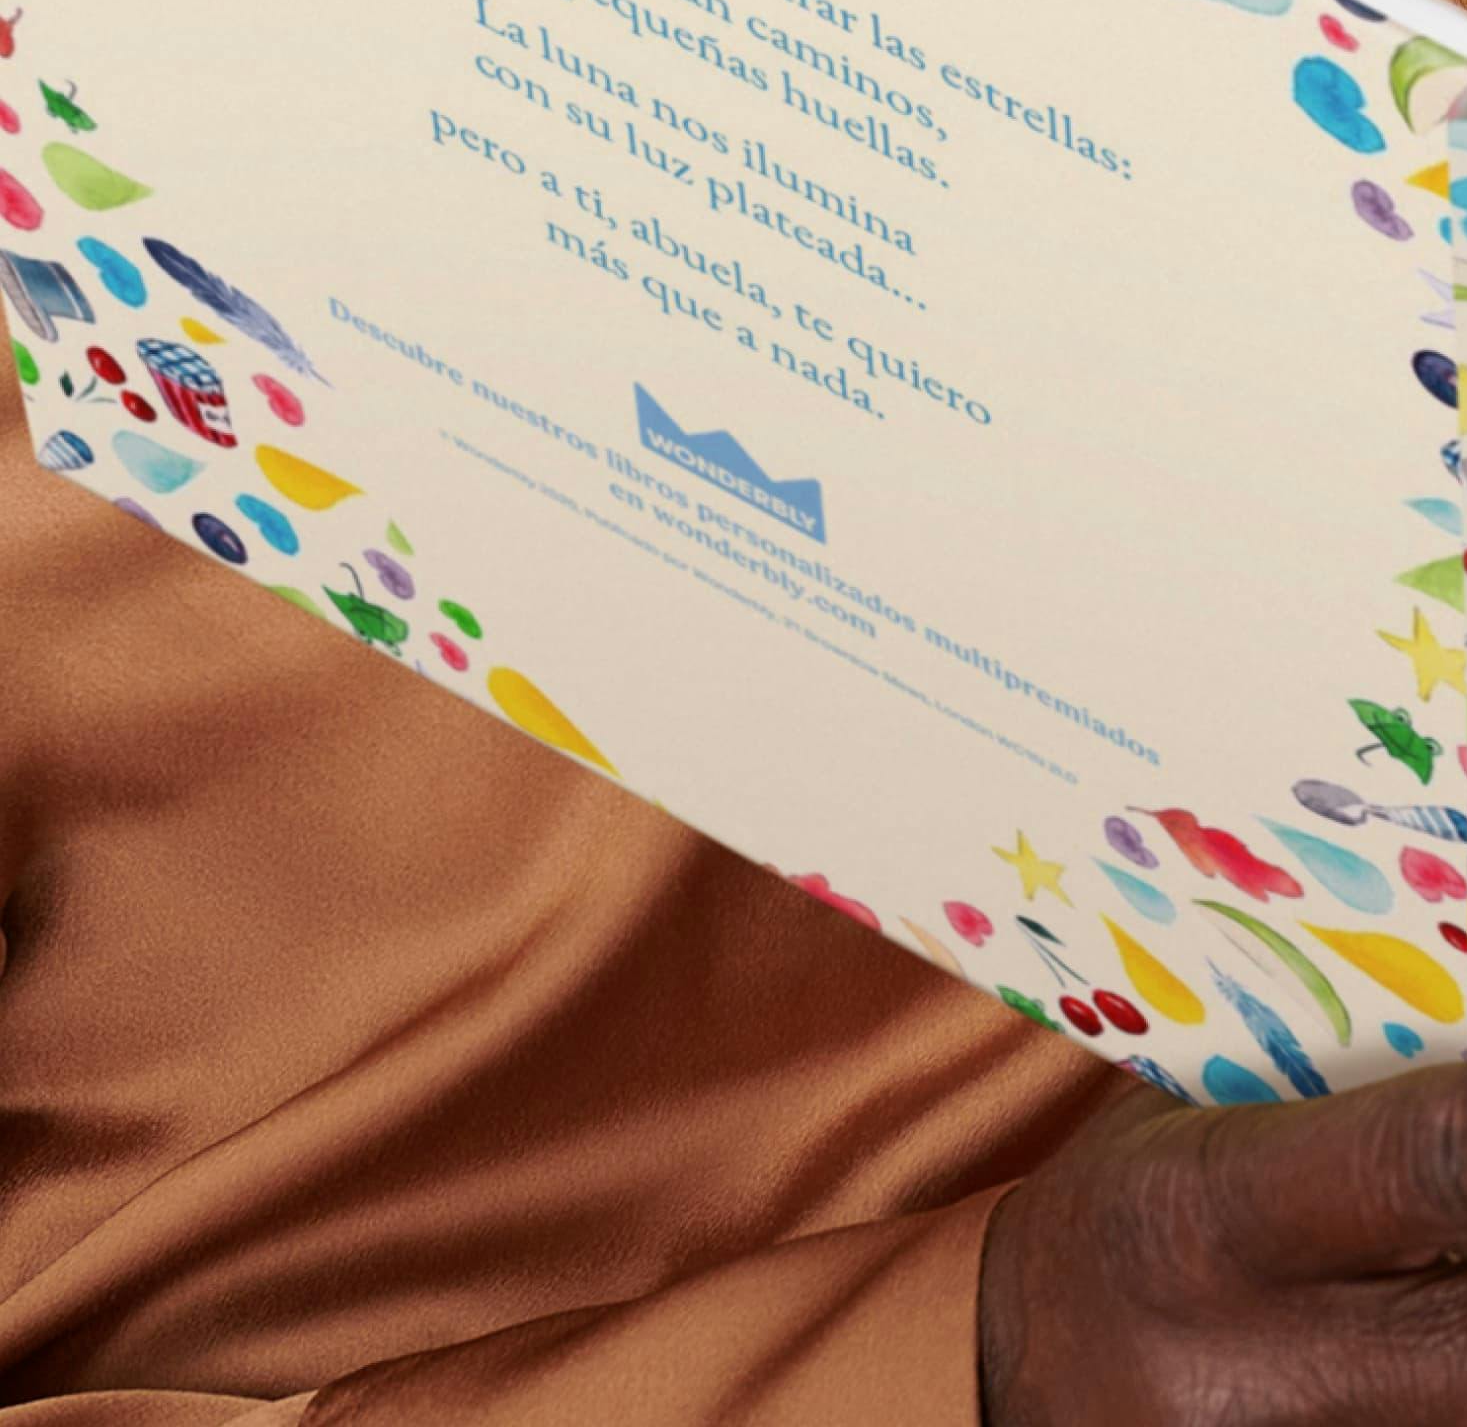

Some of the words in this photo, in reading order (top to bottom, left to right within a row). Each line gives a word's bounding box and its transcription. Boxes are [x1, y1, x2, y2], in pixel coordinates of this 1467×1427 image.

[474, 54, 551, 111] con
[565, 102, 614, 143] su
[626, 122, 693, 187] luz
[540, 26, 638, 107] luna
[651, 98, 729, 155] nos
[743, 139, 916, 257] ilumina
[746, 15, 949, 143] caminos,
[780, 68, 949, 188] huellas.
[870, 11, 927, 73] las
[939, 63, 1133, 181] estrellas:
[430, 109, 526, 176] pero
[540, 171, 564, 198] a
[575, 185, 617, 231] ti,
[631, 217, 783, 320] abuela,
[794, 303, 832, 341] te
[847, 336, 992, 427] quiero
[546, 221, 630, 282] más
[640, 275, 721, 331] que
[736, 326, 761, 354] a
[769, 342, 885, 420] nada.
[326, 295, 464, 386] Descubre
[471, 379, 598, 460] nuestros
[605, 448, 688, 509] libros
[696, 503, 917, 635] personalizados
[923, 626, 1163, 768] multipremiados
[608, 482, 646, 512] en
[651, 504, 880, 639] wonderbly.com
[646, 428, 817, 532] WONDERBLY
